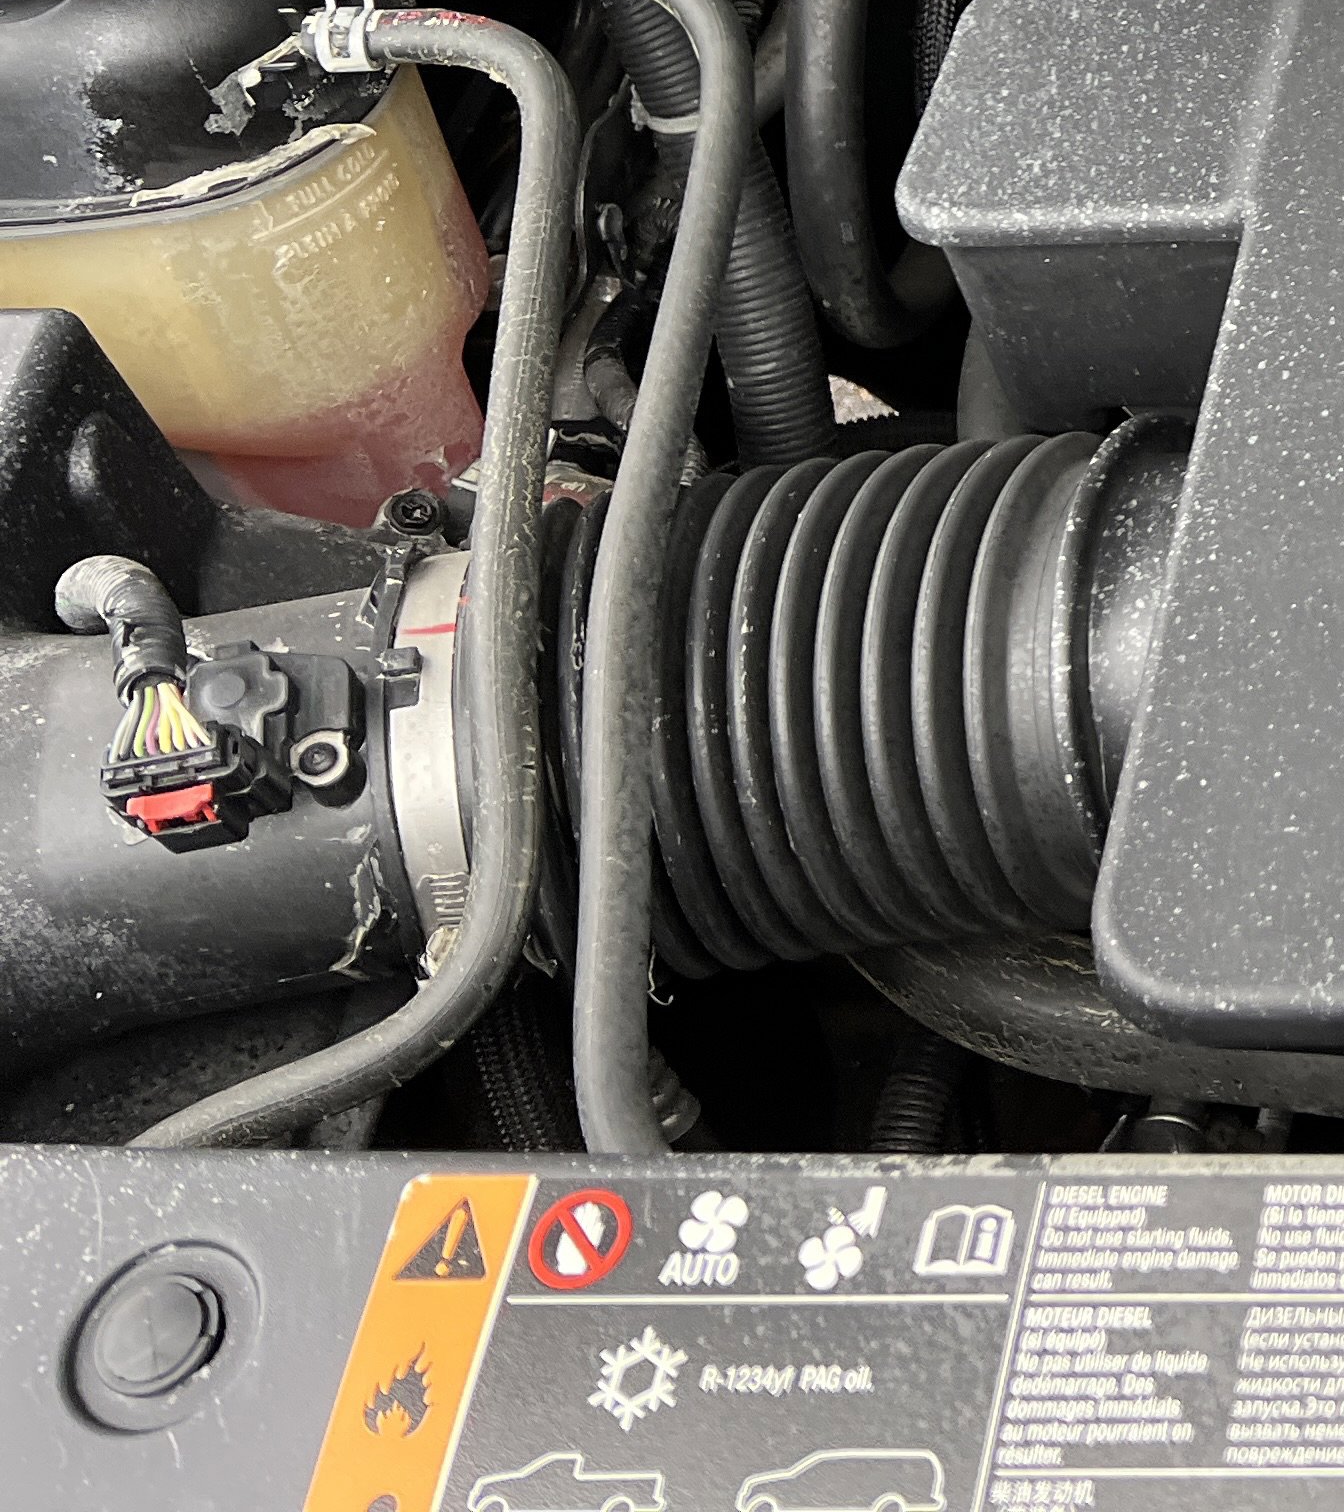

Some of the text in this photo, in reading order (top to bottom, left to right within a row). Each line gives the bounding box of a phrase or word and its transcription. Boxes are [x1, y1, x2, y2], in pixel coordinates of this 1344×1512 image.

[285, 175, 336, 211] FULL
[1050, 1185, 1168, 1206] DIESEL ENGINE
[1264, 1185, 1322, 1204] MOTOR
[1068, 1207, 1147, 1228] Equipped)
[1042, 1229, 1064, 1246] Do
[1067, 1229, 1093, 1247] not
[1095, 1231, 1123, 1247] use
[1126, 1228, 1185, 1249] starting
[1258, 1228, 1281, 1245] No
[1285, 1230, 1312, 1246] use
[658, 1251, 741, 1287] AUTO
[1037, 1250, 1239, 1273] Immediate engine damage
[1255, 1249, 1277, 1267] Se
[1279, 1250, 1336, 1269] pueden
[1032, 1271, 1113, 1289] can result.
[1024, 1307, 1152, 1328] MOTEUR DIESEL
[1242, 1331, 1290, 1349] (если
[1016, 1351, 1209, 1375] Ne pas utiliser de liquide
[1238, 1354, 1264, 1369] Не
[699, 1364, 795, 1397] R-1234yf
[799, 1364, 842, 1393] PAG
[1122, 1375, 1156, 1394] Des
[1235, 1378, 1322, 1394] жидкости
[1007, 1399, 1095, 1421] dommages
[1000, 1422, 1195, 1447] au moteur pourraient en
[1228, 1423, 1300, 1441] вызвать
[989, 1479, 1095, 1506] 柴油发动机
